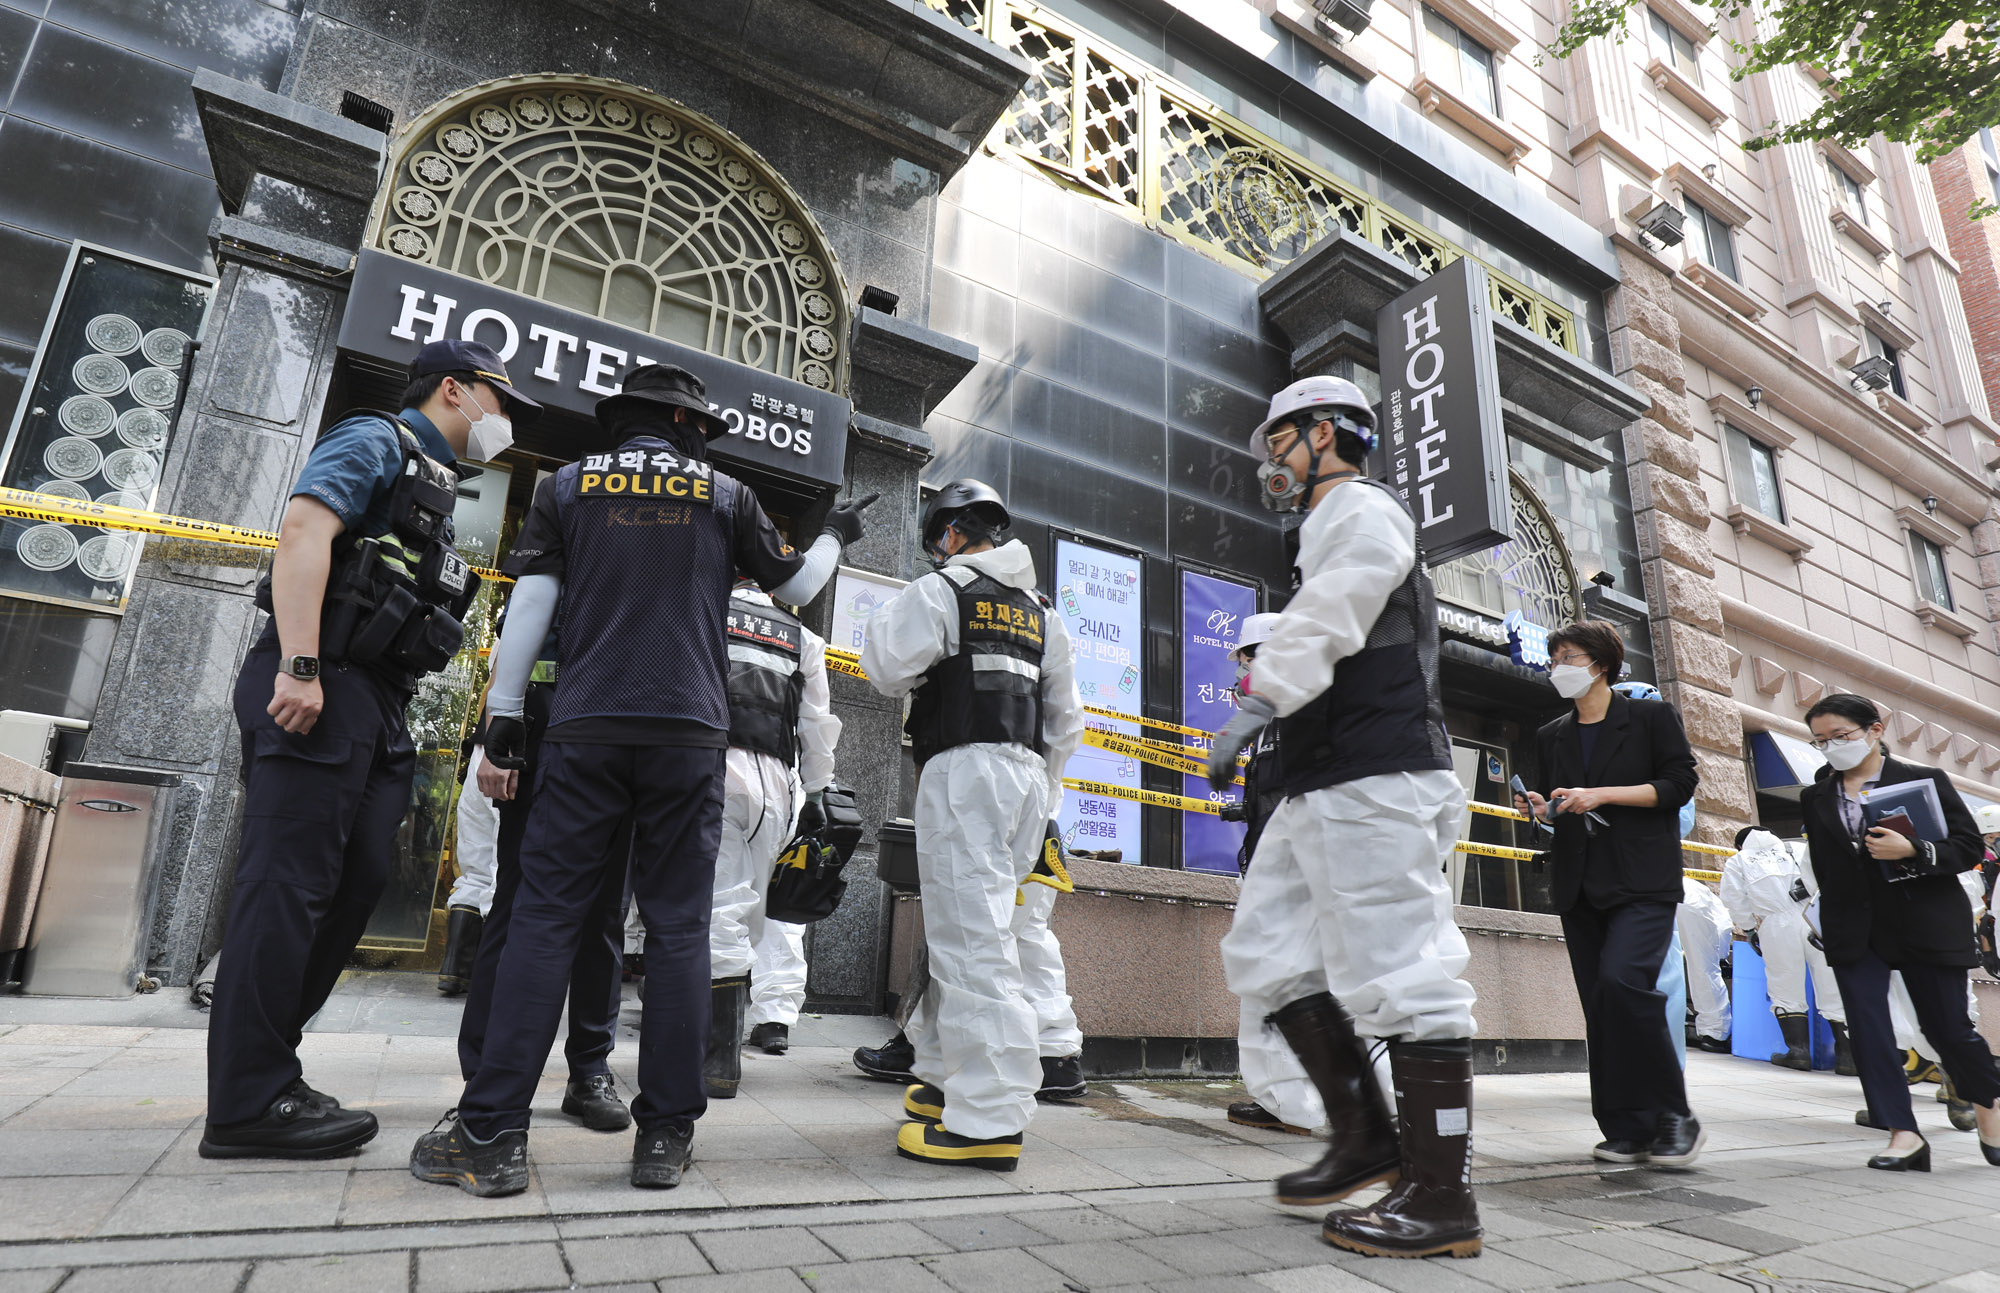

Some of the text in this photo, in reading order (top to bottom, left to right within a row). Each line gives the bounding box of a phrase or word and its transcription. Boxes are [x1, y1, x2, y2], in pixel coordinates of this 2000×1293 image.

[391, 284, 657, 397] HOTE
[751, 392, 814, 424] 관광호텔
[1391, 388, 1405, 446] 관광호텔
[1403, 295, 1453, 529] HOTEL
[708, 402, 812, 455] OBOS
[583, 450, 711, 479] 과학수사
[581, 473, 709, 500] POLICE
[1069, 560, 1088, 577] 멀리
[1090, 564, 1099, 580] 갈
[1102, 568, 1111, 583] 것
[1107, 587, 1128, 606] 해결!
[969, 620, 985, 630] Fire
[975, 601, 1040, 633] 화재조사
[1079, 617, 1121, 643] 24시간
[1437, 606, 1511, 644] market
[1095, 642, 1130, 666] 편의점
[1193, 634, 1222, 648] HOTEL
[1080, 681, 1097, 697] 소주
[1197, 682, 1214, 704] 전
[1079, 798, 1117, 818] 냉동식품
[1078, 820, 1117, 839] 생활용품
